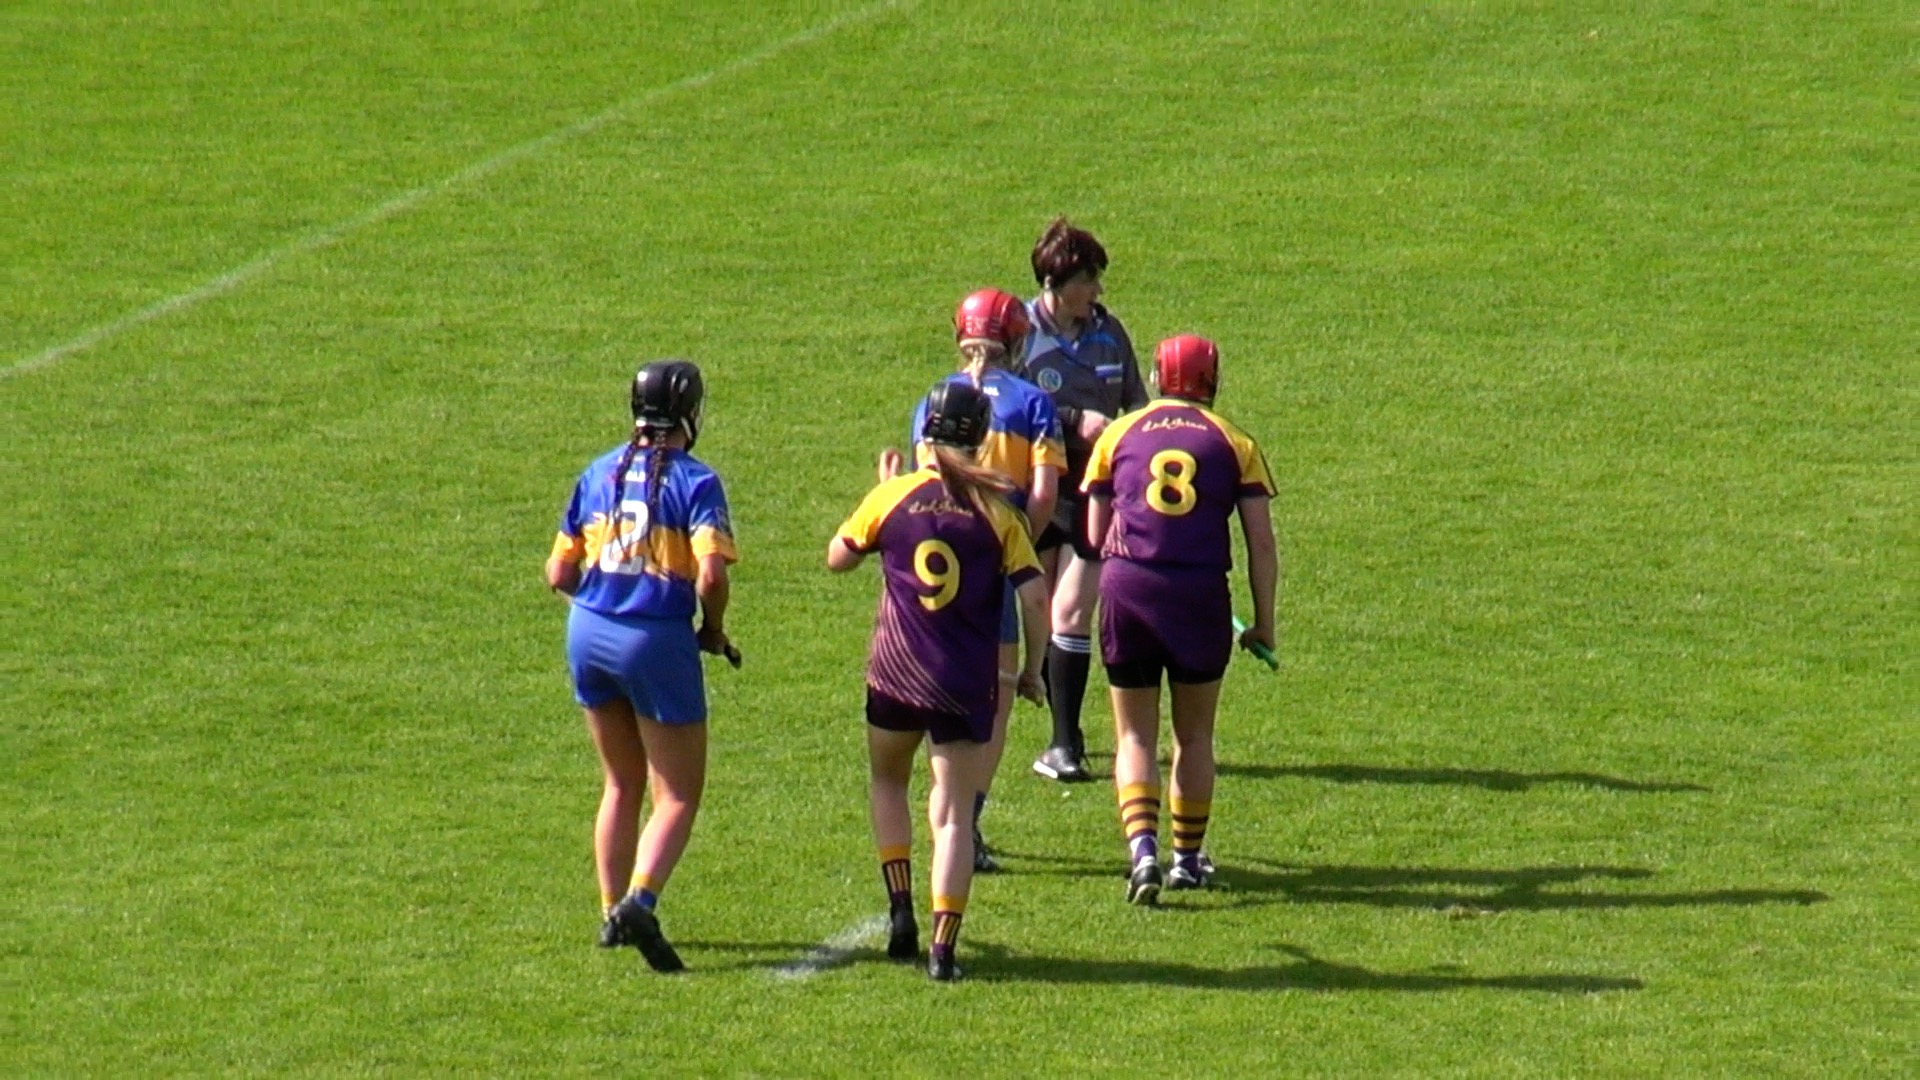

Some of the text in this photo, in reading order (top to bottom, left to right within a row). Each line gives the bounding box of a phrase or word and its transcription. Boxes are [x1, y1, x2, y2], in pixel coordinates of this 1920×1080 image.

[1146, 449, 1197, 516] 8
[600, 500, 648, 575] 2
[914, 539, 960, 611] 9
